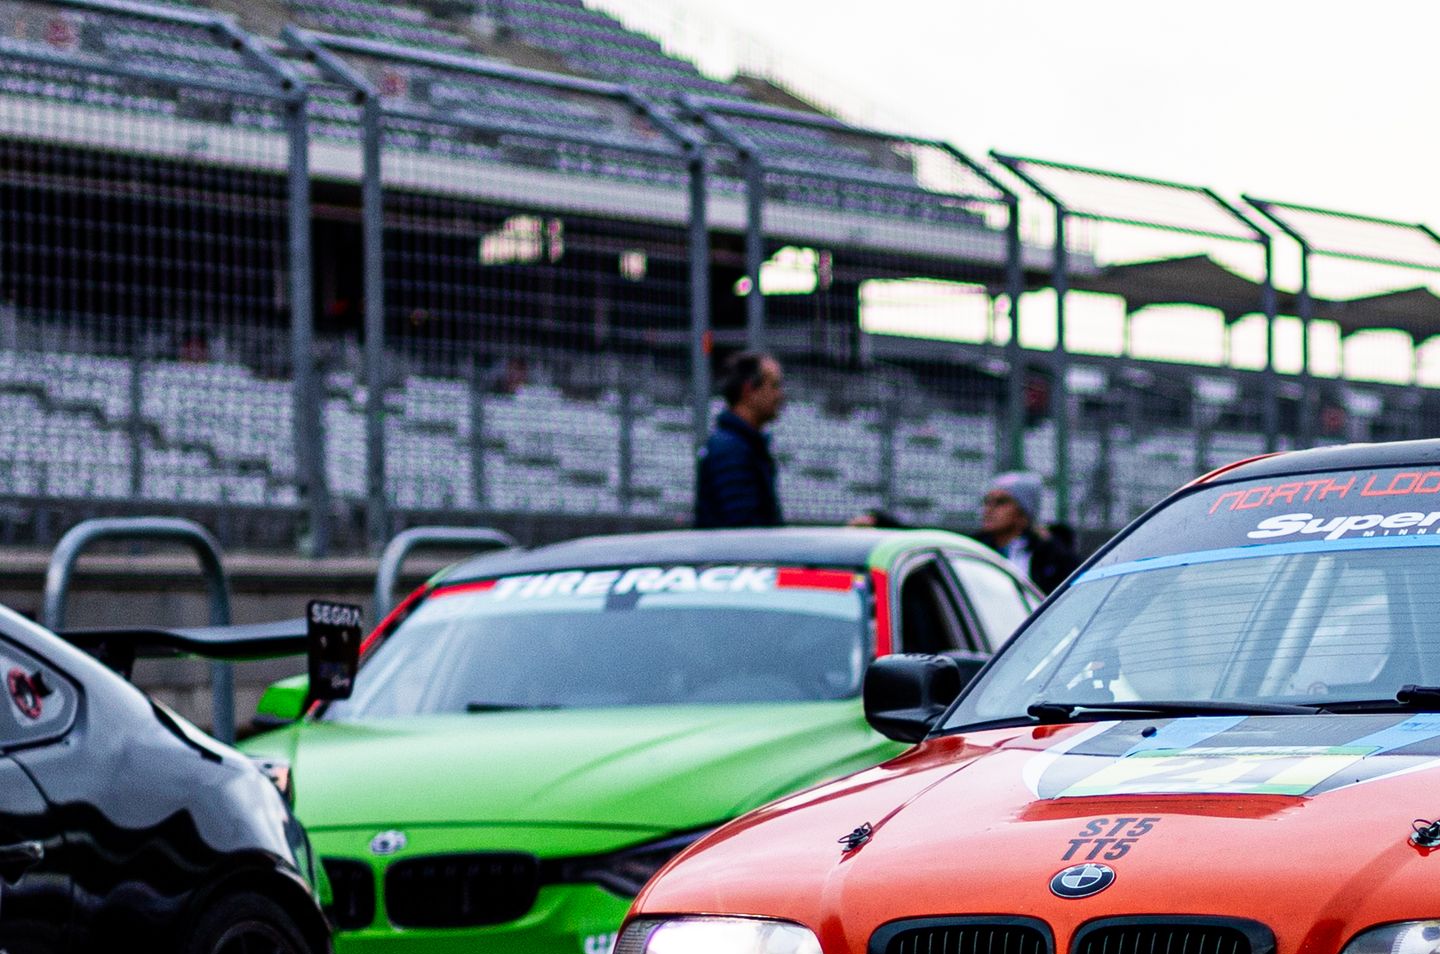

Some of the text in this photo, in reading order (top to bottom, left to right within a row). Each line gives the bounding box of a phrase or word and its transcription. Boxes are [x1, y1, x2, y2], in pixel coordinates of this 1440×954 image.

[1209, 476, 1357, 515] NORTH
[1078, 817, 1162, 838] ST5
[1060, 837, 1140, 862] TT5
